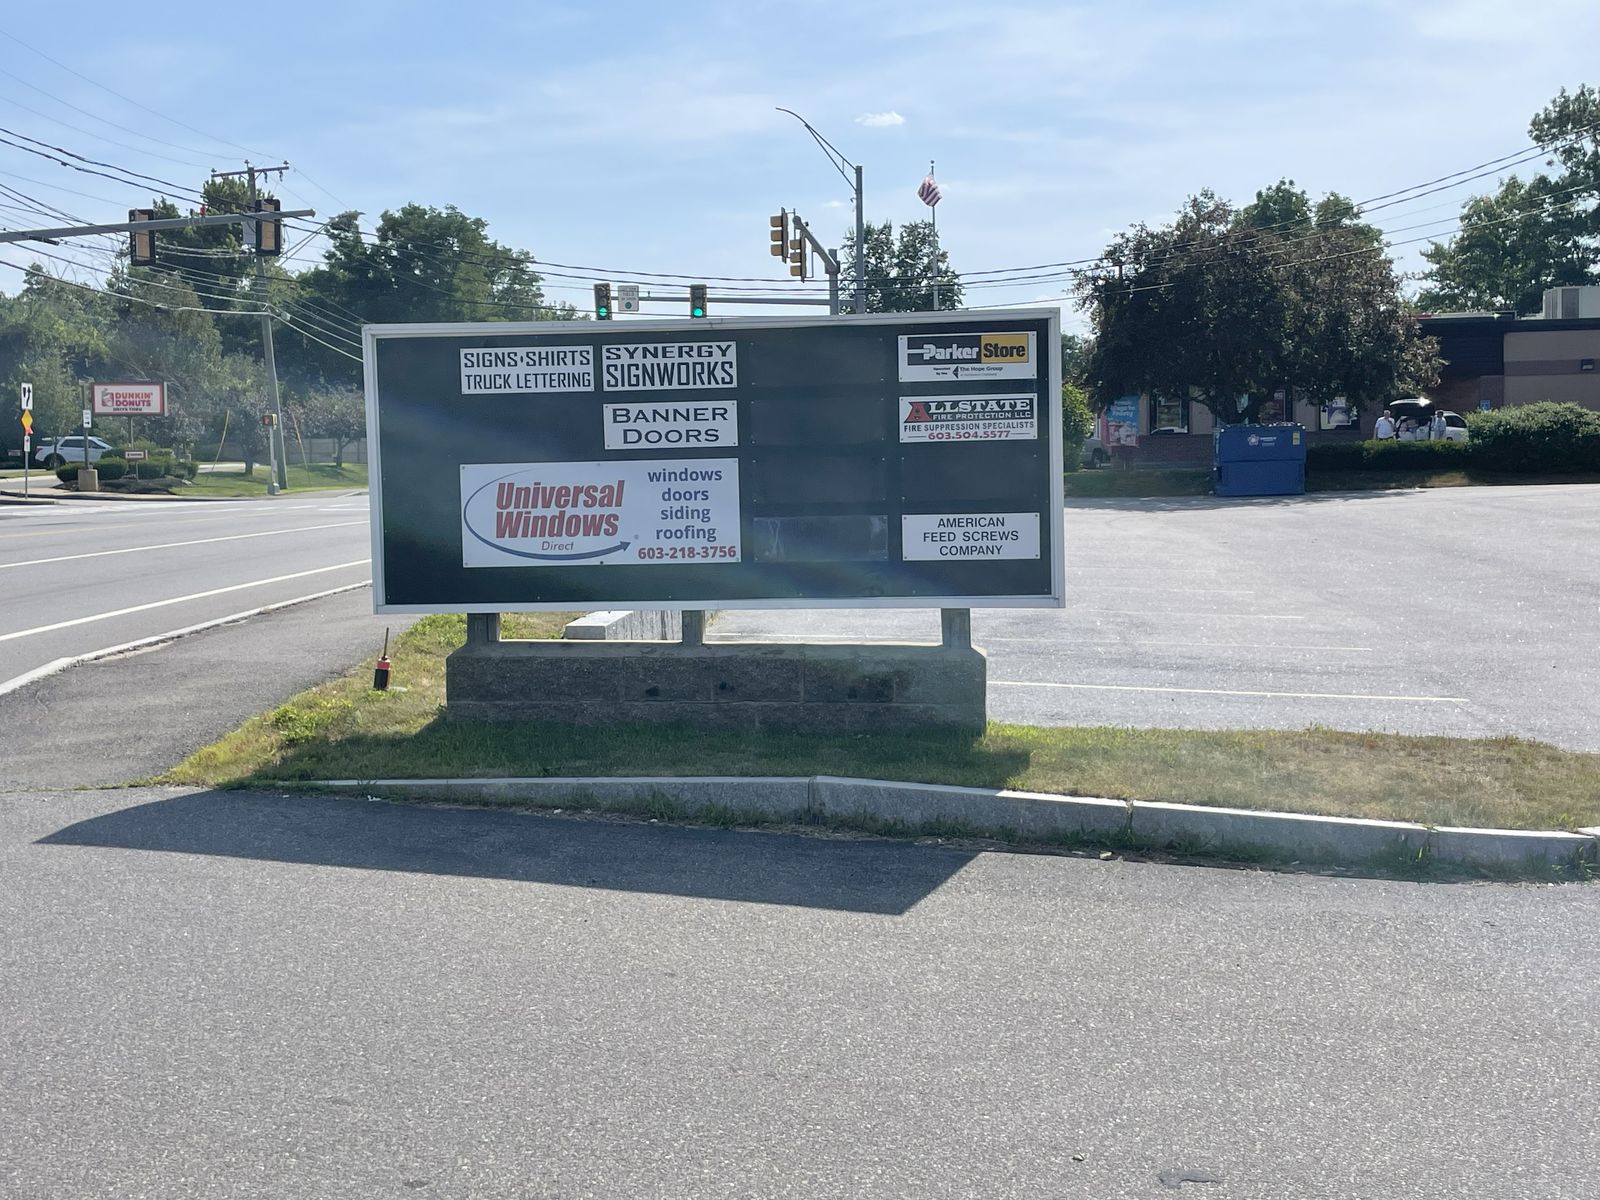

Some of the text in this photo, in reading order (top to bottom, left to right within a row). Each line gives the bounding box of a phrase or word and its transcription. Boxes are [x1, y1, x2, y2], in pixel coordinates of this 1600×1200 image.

[606, 344, 732, 360] SYNERGY
[923, 343, 1026, 360] Parker Store
[466, 372, 591, 390] TRUCK LETTERING
[606, 362, 734, 388] SIGNWORKS
[612, 408, 728, 424] BANNER
[904, 400, 1030, 423] ALLSTATE
[924, 423, 980, 431] SUPPRESSION
[983, 421, 1034, 429] SPECIALISTS
[623, 429, 719, 444] DOORS
[928, 431, 1011, 440] 603.504.5577
[648, 469, 722, 482] windows
[496, 480, 625, 509] Universal
[662, 487, 709, 502] doors
[660, 506, 711, 522] siding
[496, 511, 620, 538] Windows
[938, 517, 1004, 528] AMERICAN
[656, 526, 716, 542] roofing
[924, 531, 1018, 542] FEED SCREWS
[542, 540, 574, 551] Direct
[638, 546, 736, 559] 603-218-3756
[940, 546, 1002, 556] COMPANY
